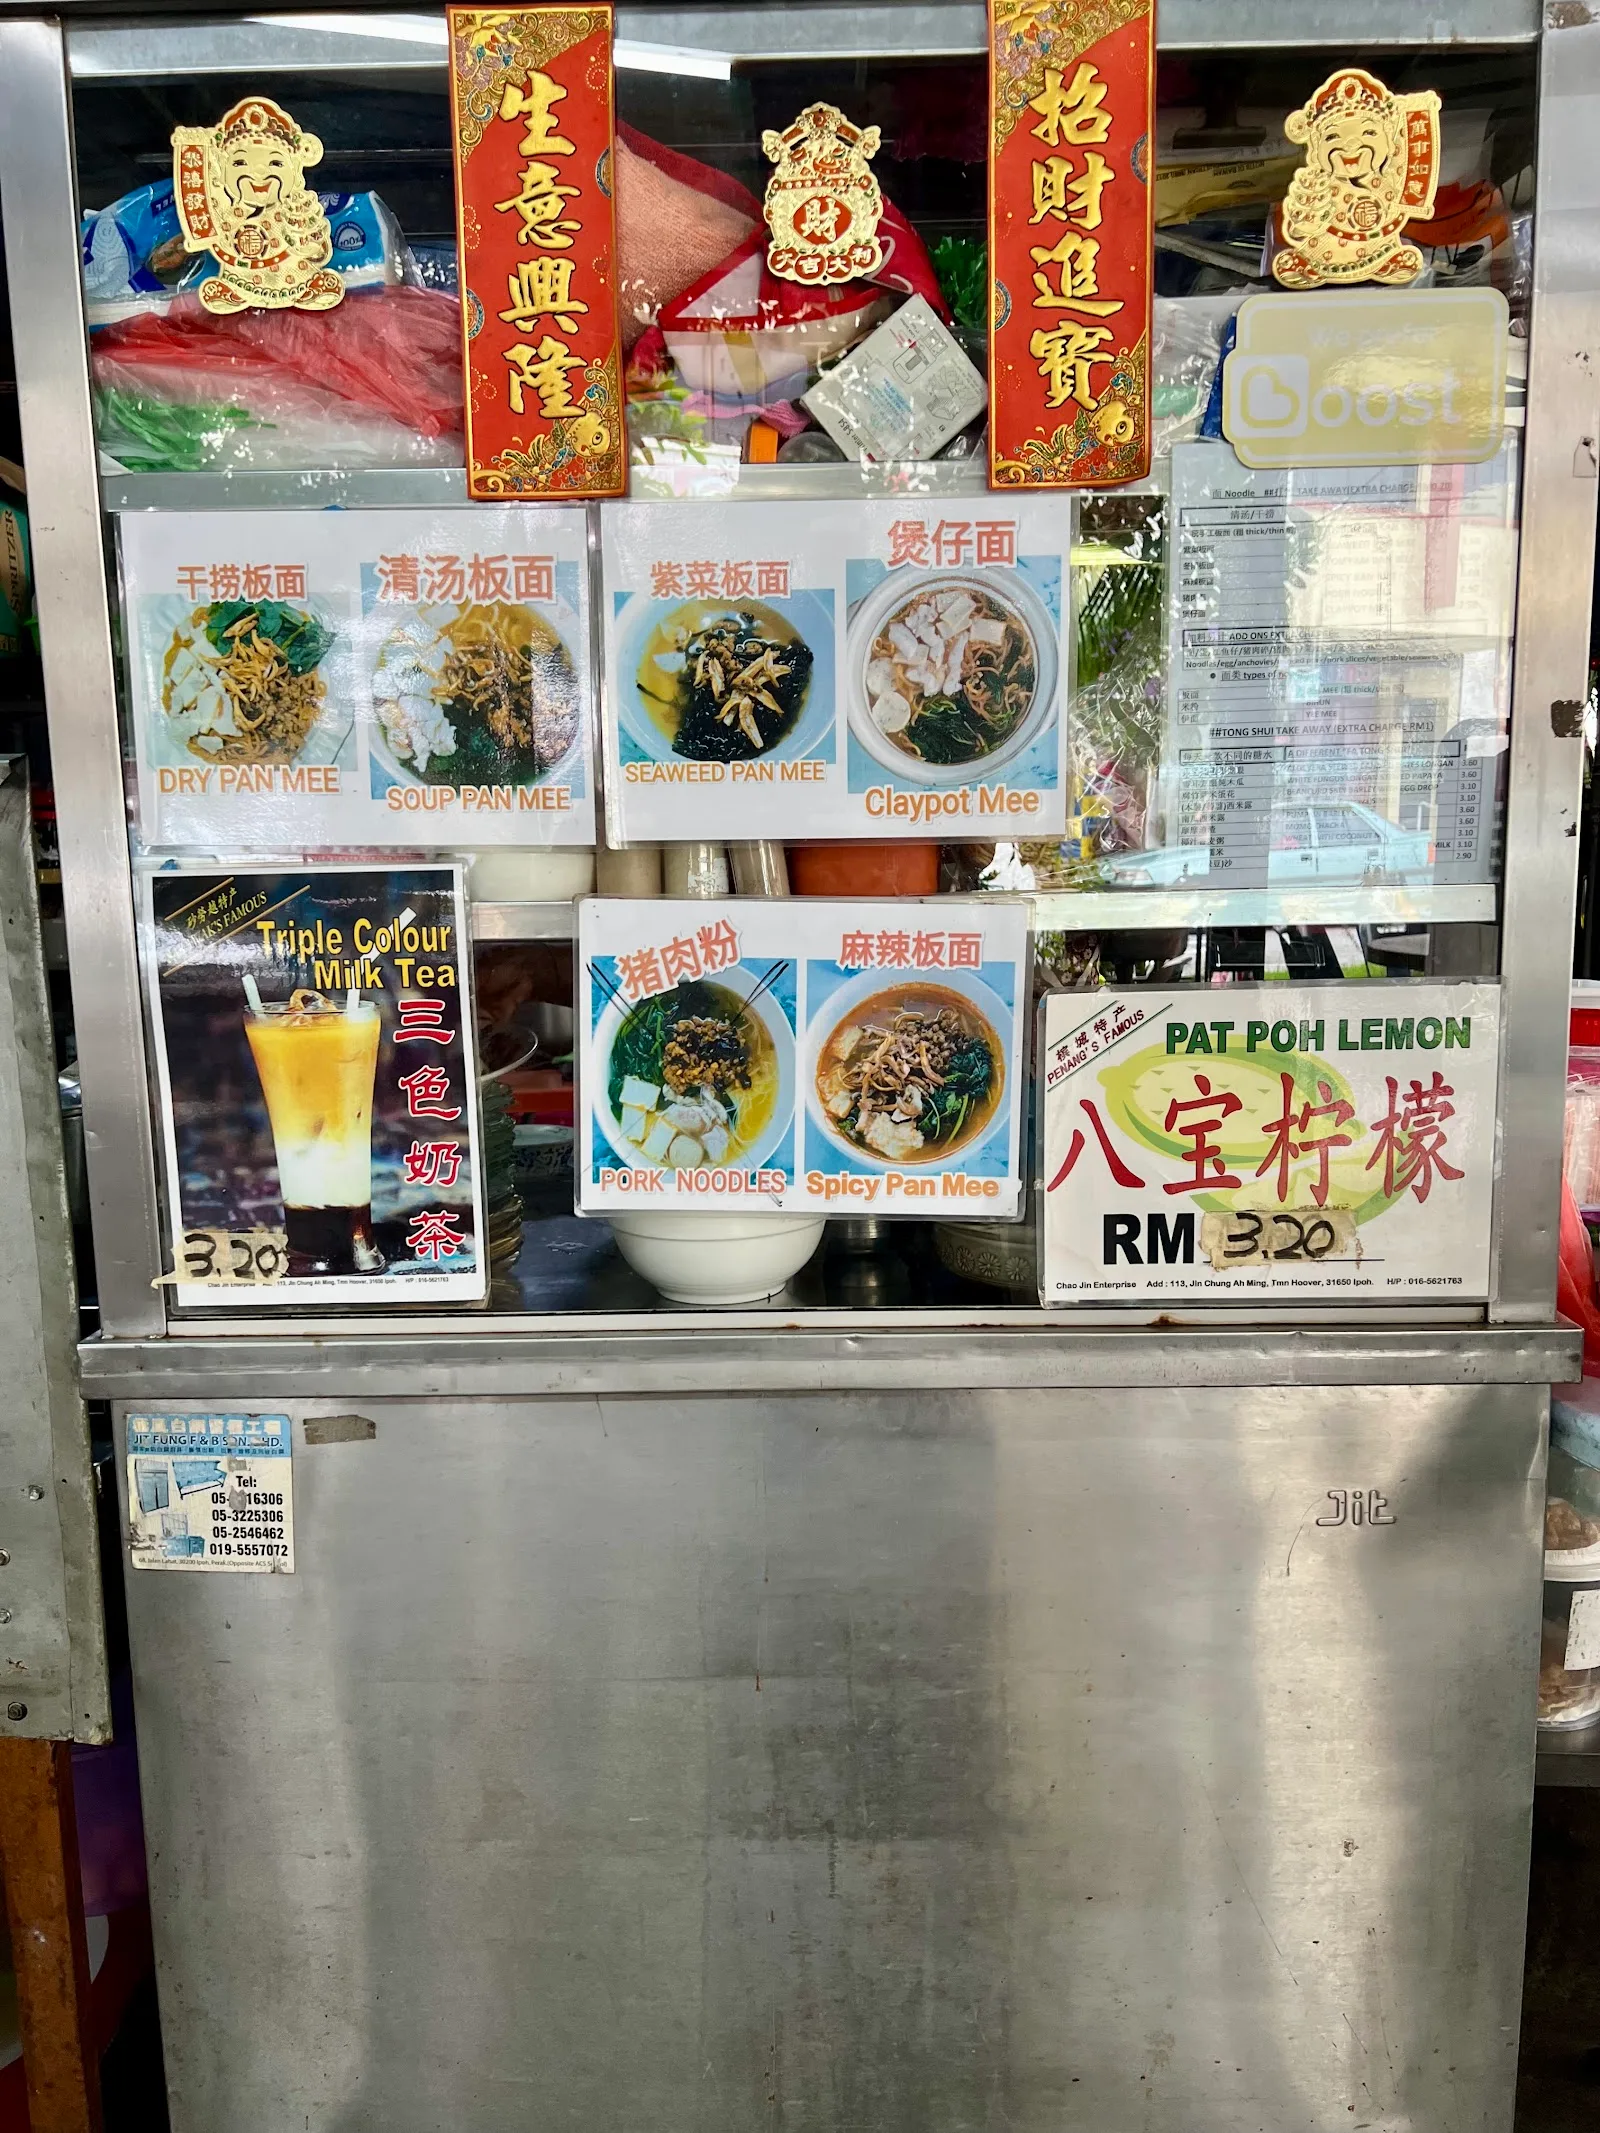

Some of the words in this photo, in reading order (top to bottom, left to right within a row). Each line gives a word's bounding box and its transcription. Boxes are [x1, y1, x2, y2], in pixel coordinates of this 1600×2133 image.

[800, 197, 841, 242] 財
[494, 70, 589, 418] 生意興隆
[1028, 62, 1125, 411] 招財進寶
[775, 246, 872, 275] 大吉大利
[1224, 489, 1255, 497] Noodle
[1298, 487, 1319, 495] TAKE
[1380, 484, 1416, 493] CHARGE
[888, 519, 1016, 566] 煲仔面
[1246, 527, 1285, 535] thick/thin
[5, 510, 20, 613] SPRITZER
[177, 563, 306, 600] 干捞板面
[379, 554, 555, 601] 清汤板面
[651, 559, 790, 598] 紫菜板面
[1230, 632, 1248, 640] ADD
[1250, 631, 1268, 640] ONS
[1243, 671, 1265, 680] types
[1210, 728, 1249, 738] ##TONG
[1251, 728, 1274, 736] SHUI
[1277, 726, 1299, 735] TAKE
[1302, 725, 1331, 734] AWAY
[1334, 722, 1366, 732] (EXTRA
[1369, 722, 1407, 731] CHARGE
[1409, 721, 1434, 730] RM1)
[1296, 748, 1340, 756] DIFFERENT
[160, 768, 210, 795] DRY
[220, 766, 278, 794] PAN
[282, 766, 340, 793] MEE
[625, 762, 725, 783] SEAWEED
[732, 762, 774, 783] PAN
[780, 761, 825, 782] MEE
[1288, 776, 1311, 784] WHITE
[1313, 775, 1344, 783] FUNGUS
[388, 787, 457, 811] SOUP
[462, 787, 513, 811] PAN
[520, 786, 570, 810] MEE
[1401, 784, 1415, 792] EGG
[865, 787, 970, 826] Claypot
[979, 787, 1039, 814] Mee
[223, 891, 267, 928] FAMOUS
[256, 920, 343, 964] Triple
[353, 917, 451, 954] Colour
[840, 929, 982, 968] 麻辣板面
[314, 957, 384, 990] Milk
[393, 957, 456, 989] Tea
[619, 919, 742, 1001] 猪肉粉
[1047, 1041, 1099, 1084] PENANG'S
[1104, 1009, 1145, 1044] FAMOUS
[1056, 1004, 1126, 1062] 槟城特产
[1165, 1021, 1235, 1055] PAT
[1246, 1019, 1325, 1052] POH
[1338, 1016, 1471, 1051] LEMON
[393, 998, 466, 1262] 三色奶茶
[1047, 1071, 1465, 1207] 八宝柠檬
[601, 1169, 664, 1193] PORK
[677, 1169, 787, 1194] NOODLES
[806, 1174, 879, 1201] Spicy
[886, 1175, 938, 1197] Pan
[943, 1175, 999, 1197] Mee
[1103, 1213, 1195, 1266] RM
[1223, 1211, 1335, 1261] 3.20
[184, 1233, 280, 1279] 3.20
[297, 1279, 313, 1287] Chung
[1079, 1281, 1092, 1289] Jin
[1094, 1281, 1137, 1290] Enterprise
[1146, 1280, 1164, 1288] Add
[1170, 1280, 1188, 1289] 113,
[1204, 1279, 1231, 1288] Chung
[1233, 1279, 1245, 1287] Ah
[1246, 1279, 1269, 1289] Ming,
[1291, 1279, 1324, 1287] Hoover,
[1326, 1278, 1351, 1286] 31650
[1353, 1278, 1374, 1287] Ipoh.
[1387, 1277, 1402, 1285] H/P
[1408, 1277, 1462, 1285] 016-5621763
[153, 1435, 186, 1445] FUNG
[190, 1436, 197, 1444] F
[200, 1436, 209, 1445] &
[212, 1436, 219, 1445] B
[236, 1475, 257, 1488] Tel:
[211, 1493, 283, 1505] 05-16306
[1316, 1489, 1397, 1526] Jit
[212, 1509, 284, 1522] 05-3225306
[213, 1526, 284, 1539] 05-2546462
[210, 1543, 288, 1556] 019-5557072
